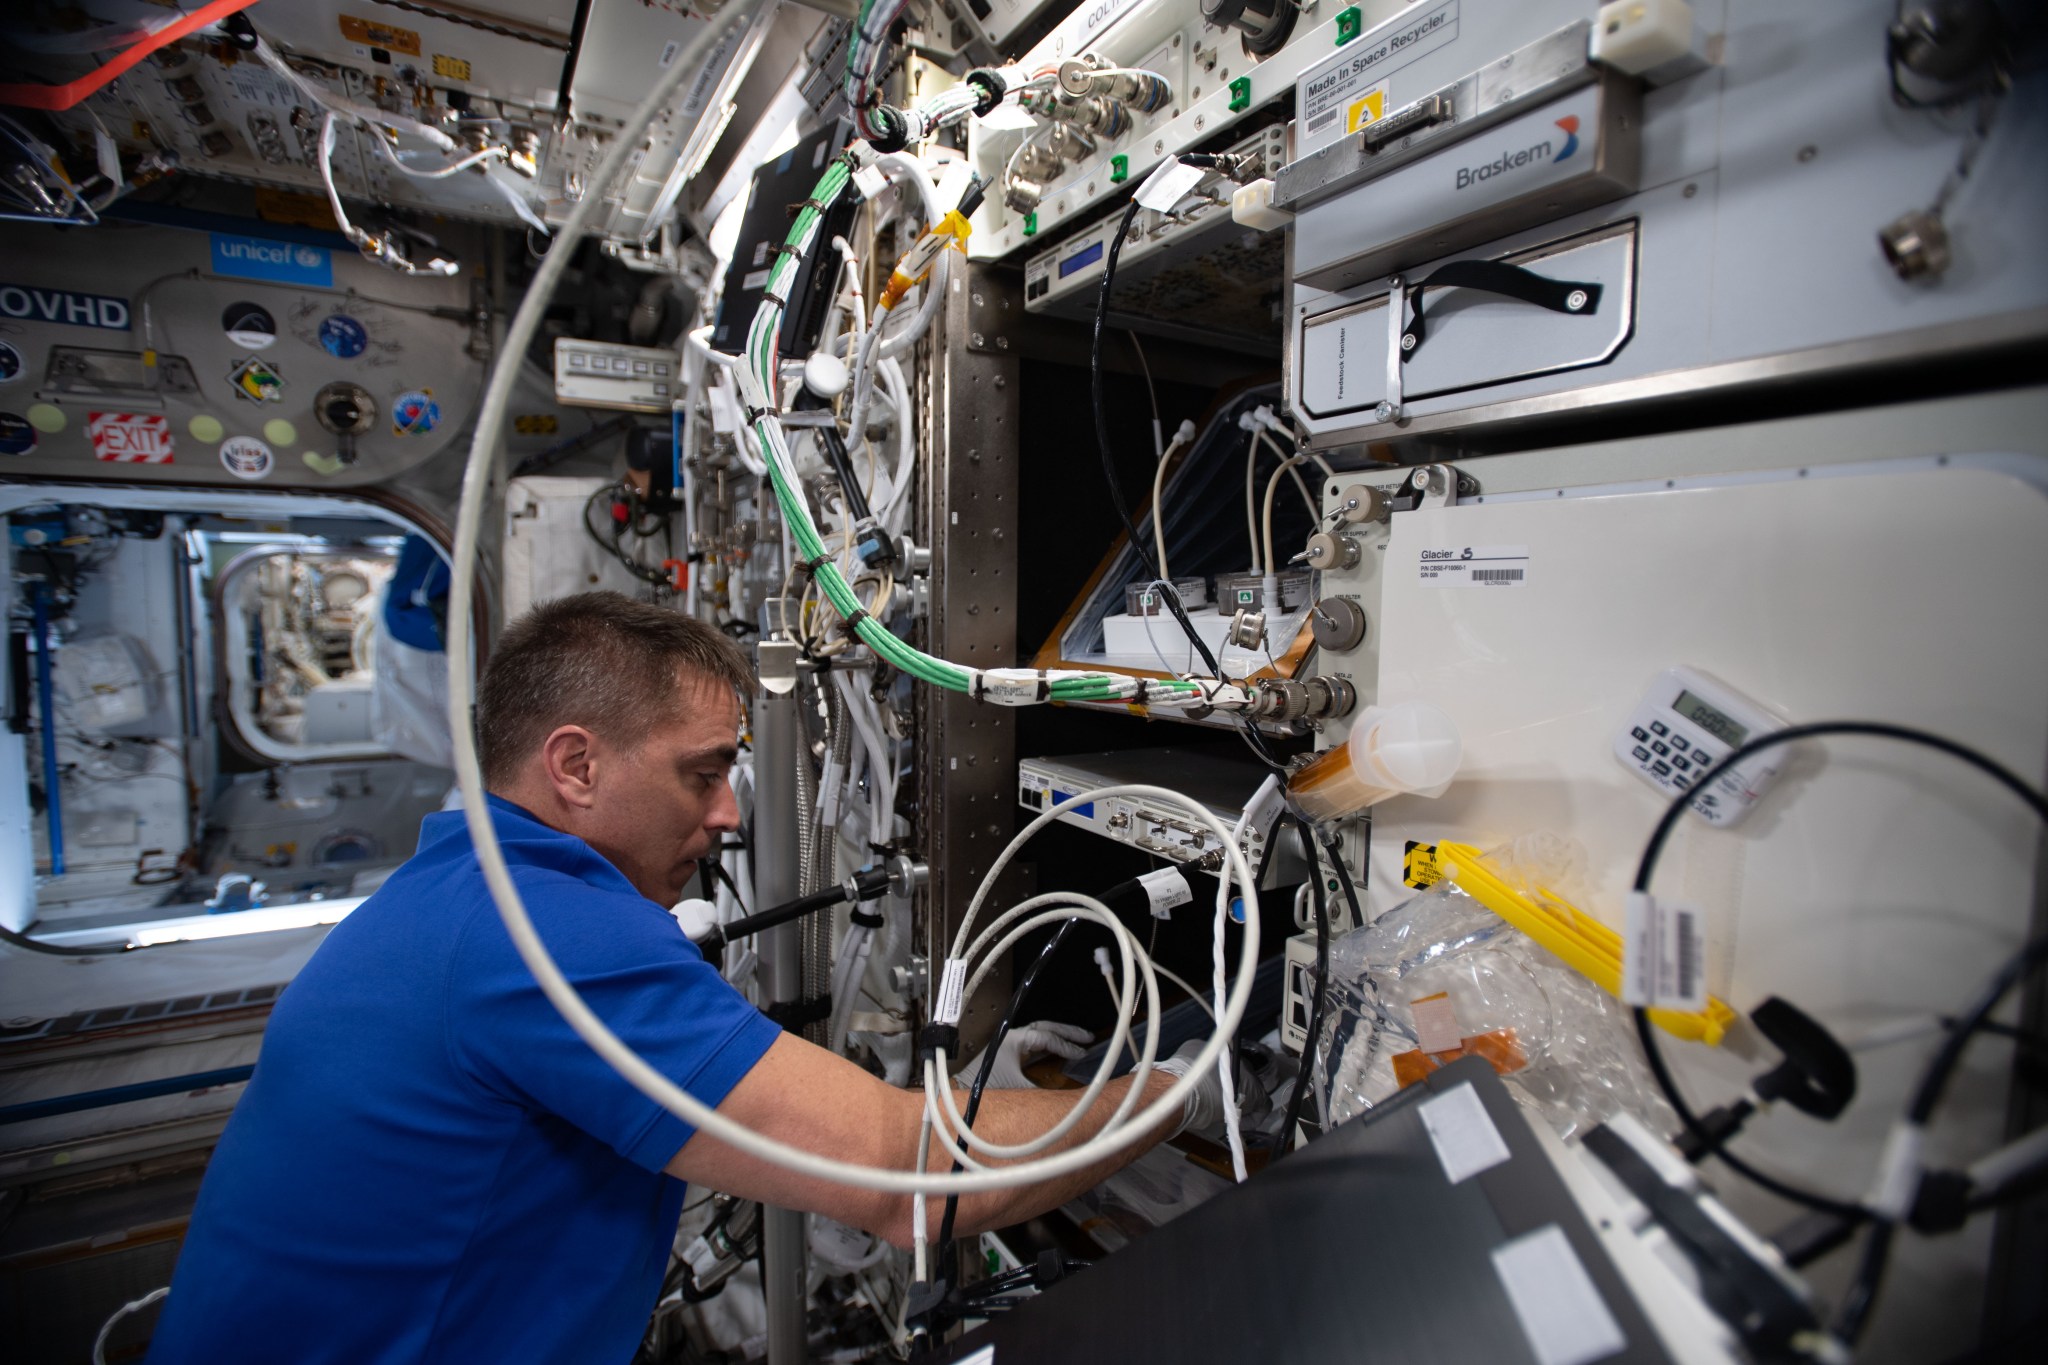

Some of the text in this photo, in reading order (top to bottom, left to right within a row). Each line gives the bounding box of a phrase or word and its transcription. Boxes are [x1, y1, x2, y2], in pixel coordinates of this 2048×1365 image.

[1308, 12, 1446, 98] Made In Space Recycler
[1362, 110, 1368, 123] 2
[1374, 106, 1422, 134] SECURED
[1456, 141, 1551, 190] Braskem
[221, 241, 291, 263] unicef
[0, 287, 129, 328] OVHD
[103, 425, 158, 452] EXIT
[1421, 549, 1454, 559] Glacier
[1417, 860, 1434, 869] WHEN
